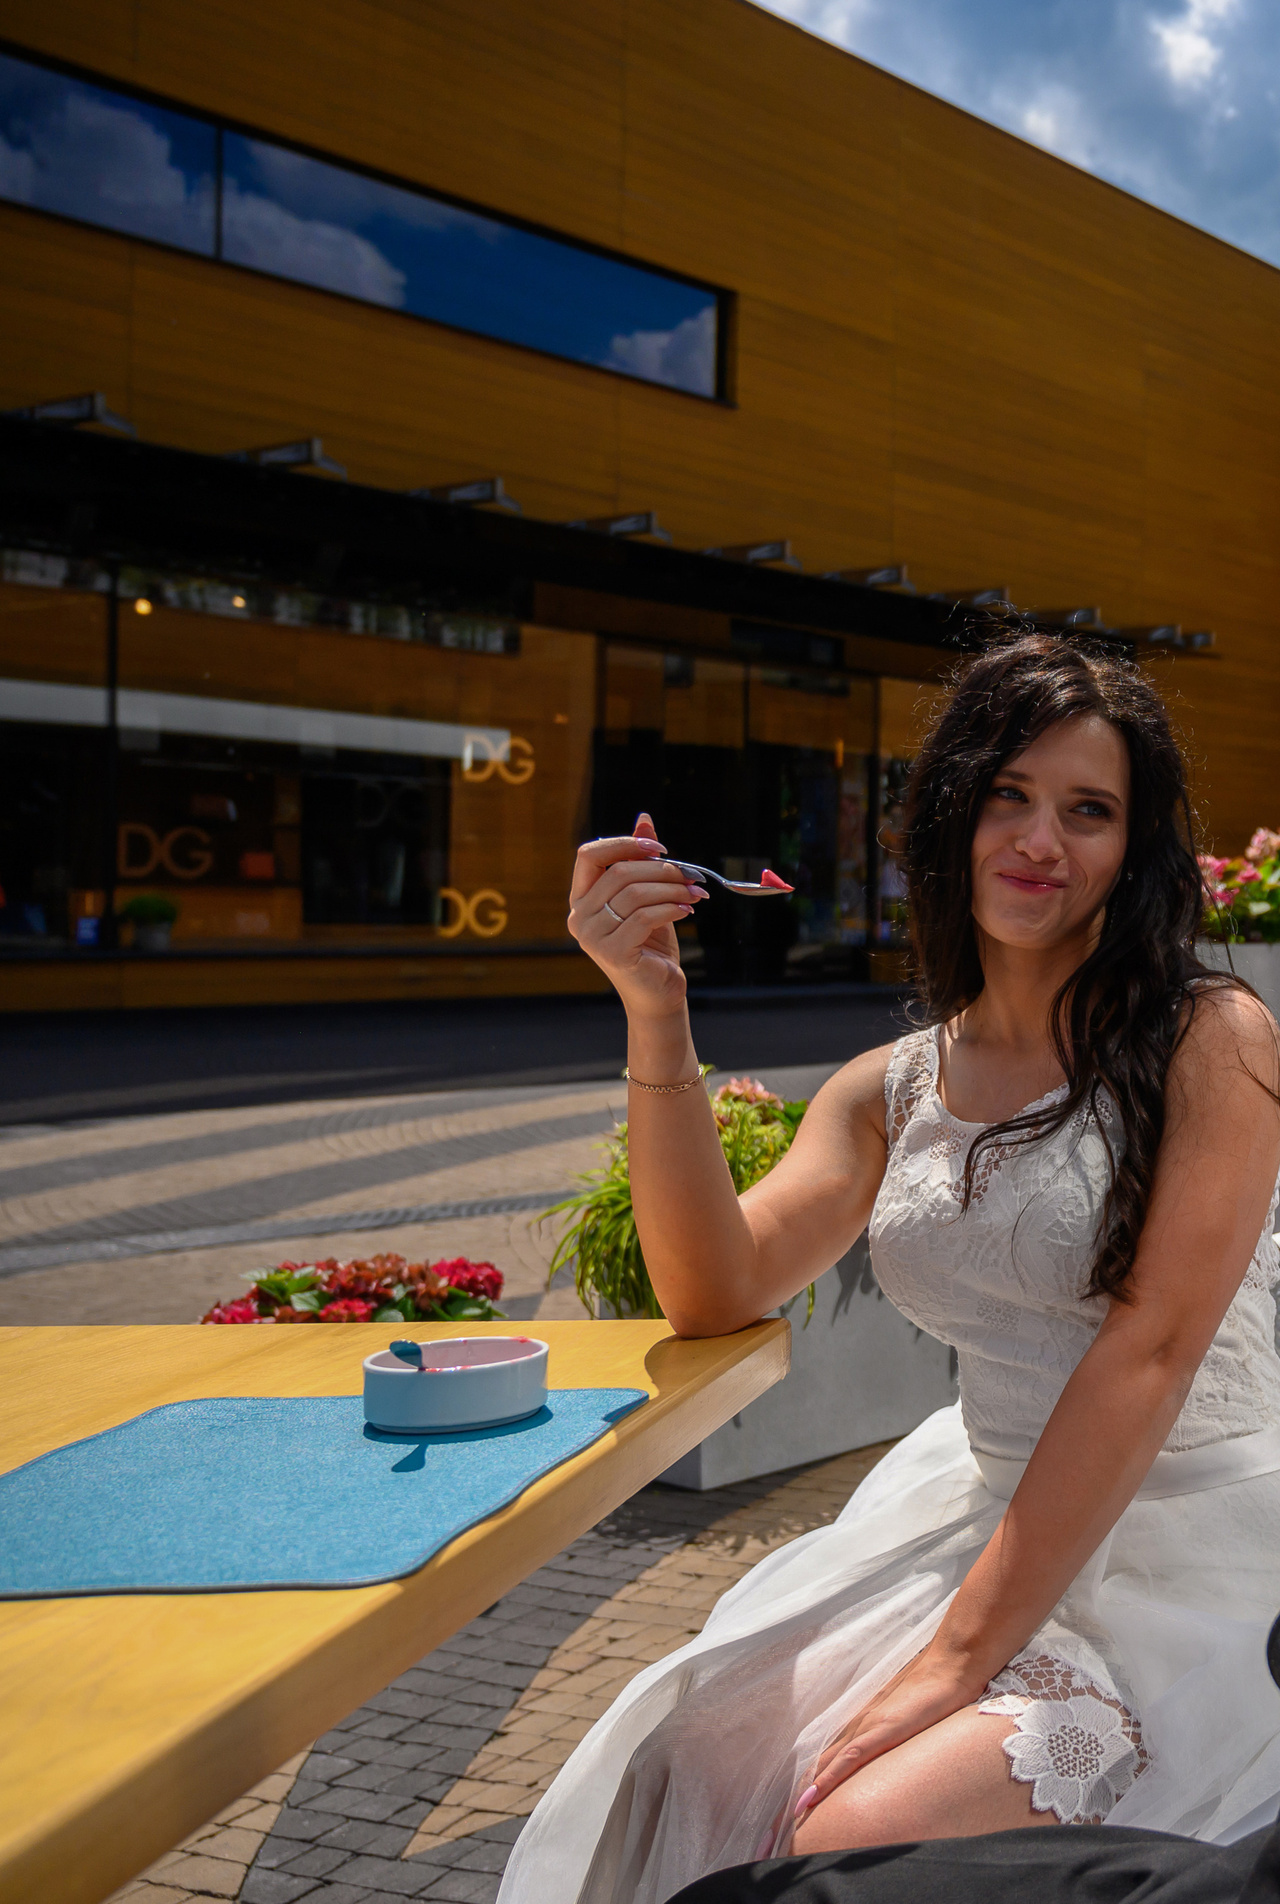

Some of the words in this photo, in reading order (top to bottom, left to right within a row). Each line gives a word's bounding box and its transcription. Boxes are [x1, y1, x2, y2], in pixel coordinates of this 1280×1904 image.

[463, 734, 535, 784] DG
[117, 822, 214, 880] DG
[437, 888, 508, 938] DG
